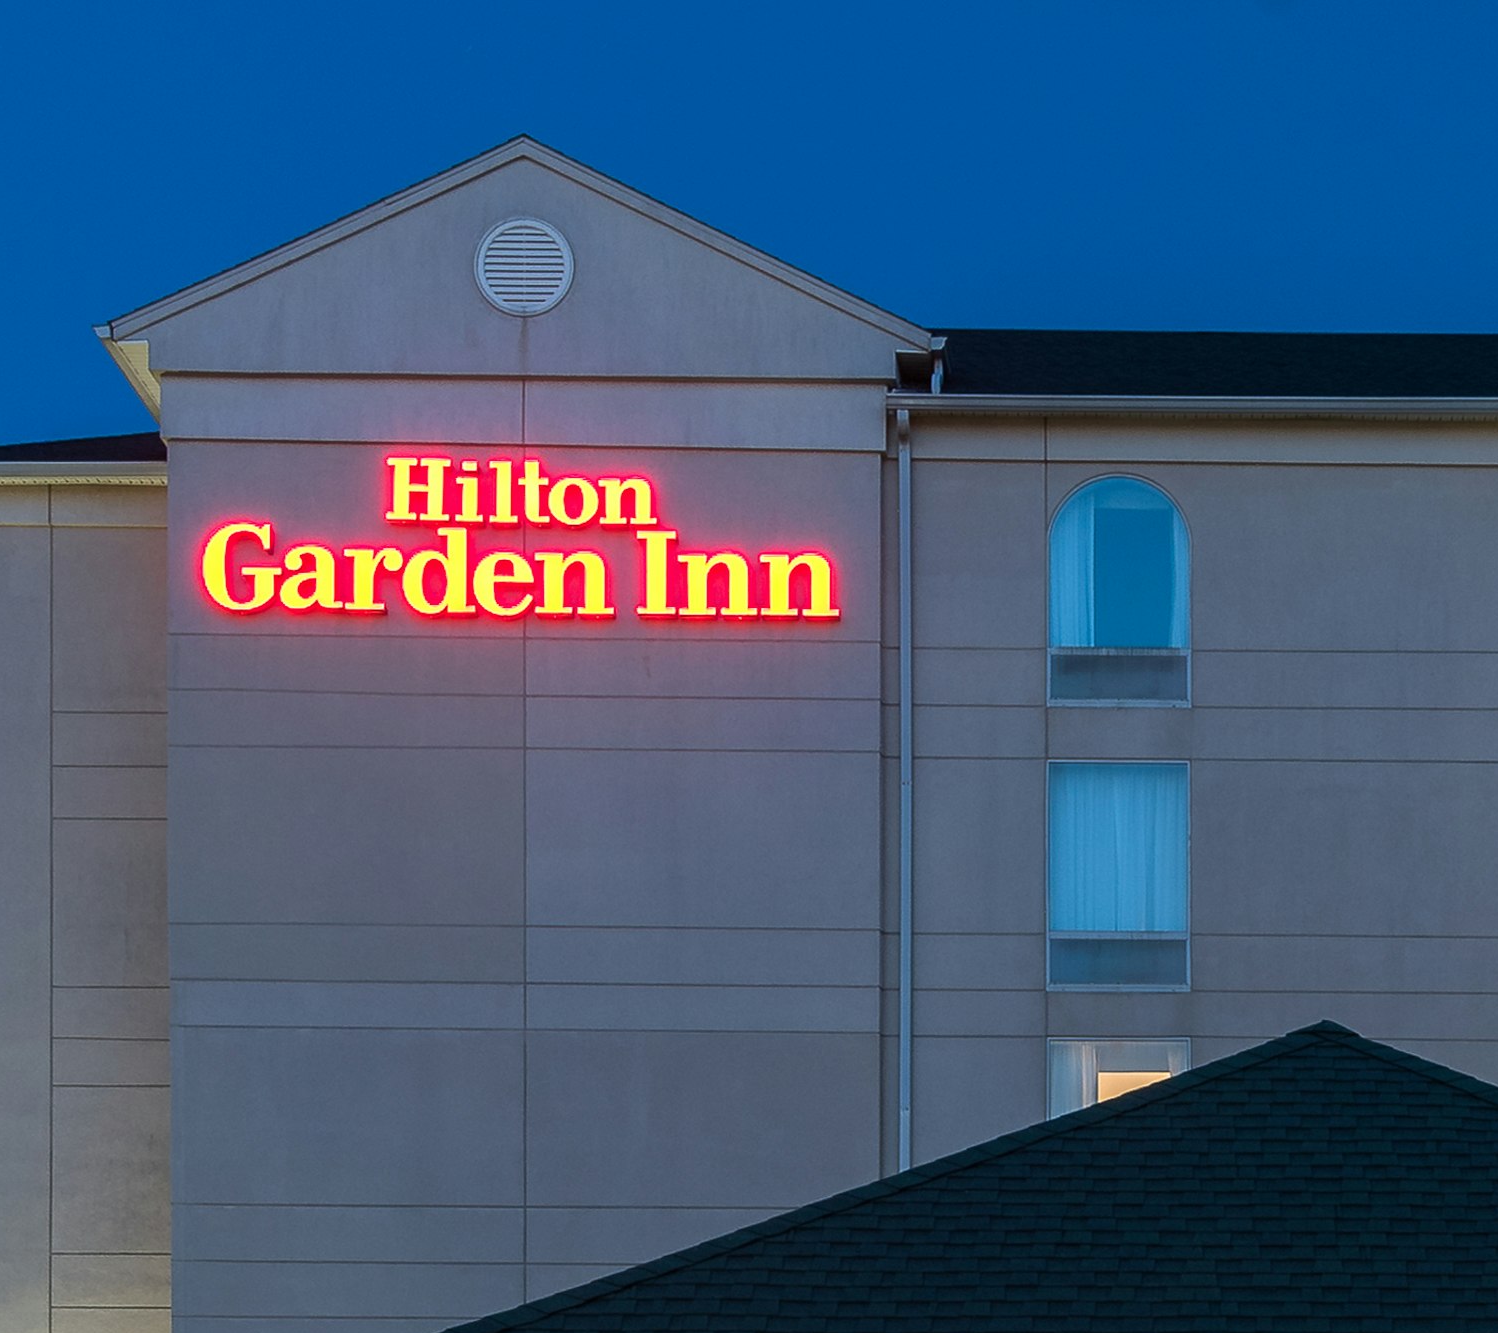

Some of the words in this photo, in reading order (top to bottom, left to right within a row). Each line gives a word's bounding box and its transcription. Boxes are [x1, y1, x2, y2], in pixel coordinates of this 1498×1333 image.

[386, 457, 658, 527] Hilton
[202, 523, 615, 617] Garden
[636, 530, 840, 618] Inn
